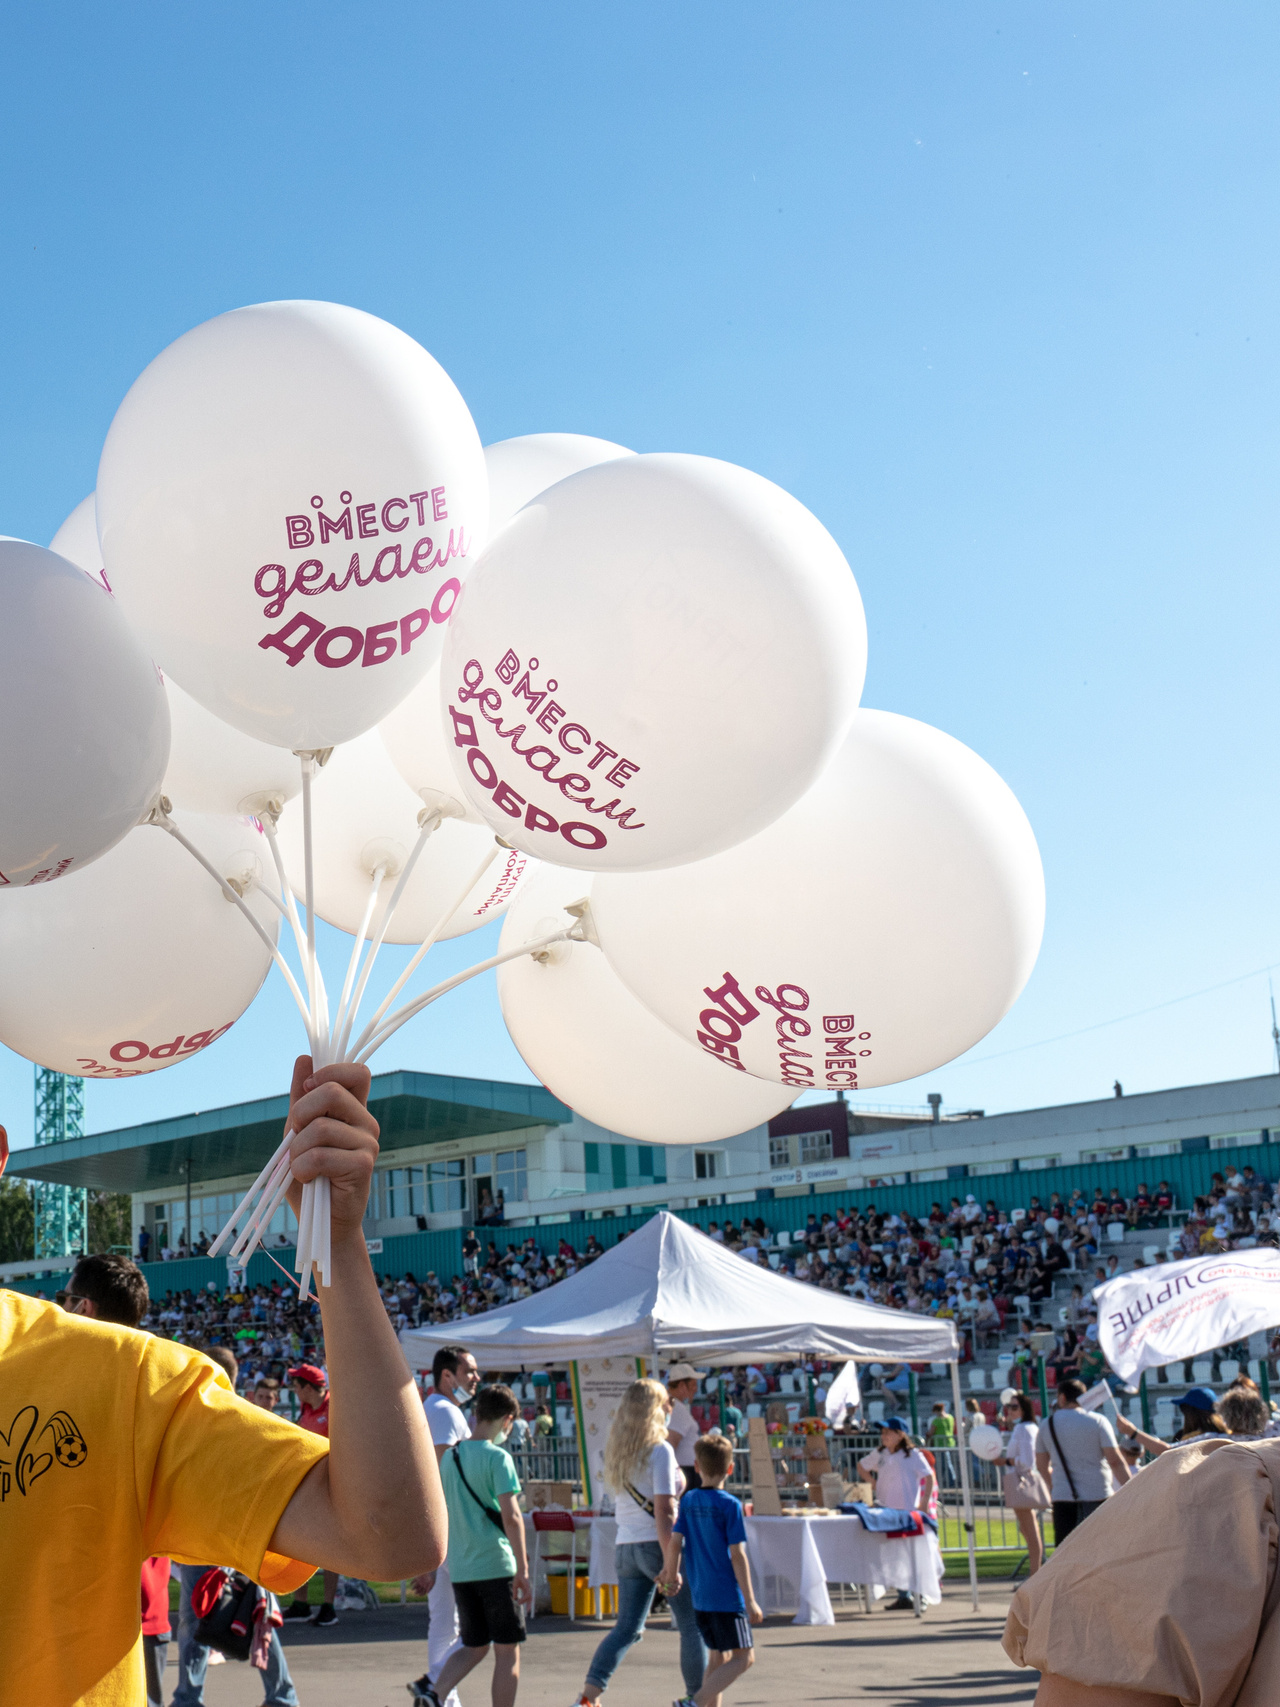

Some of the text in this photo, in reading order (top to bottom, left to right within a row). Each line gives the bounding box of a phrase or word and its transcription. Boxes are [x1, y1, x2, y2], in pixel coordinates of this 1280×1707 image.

[285, 486, 448, 550] ВМЕСТЕ
[254, 526, 472, 618] делаем
[258, 577, 462, 668] ДОБРО
[458, 659, 646, 830] делаем
[494, 648, 641, 789] ВМЕСТЕ
[448, 705, 608, 850] ДОБРО
[473, 849, 519, 915] КОМПАНИЙ
[493, 859, 527, 906] ГРУППА
[696, 971, 761, 1071] ДОБР
[754, 983, 816, 1086] делае
[822, 1014, 872, 1091] ВМЕСТ
